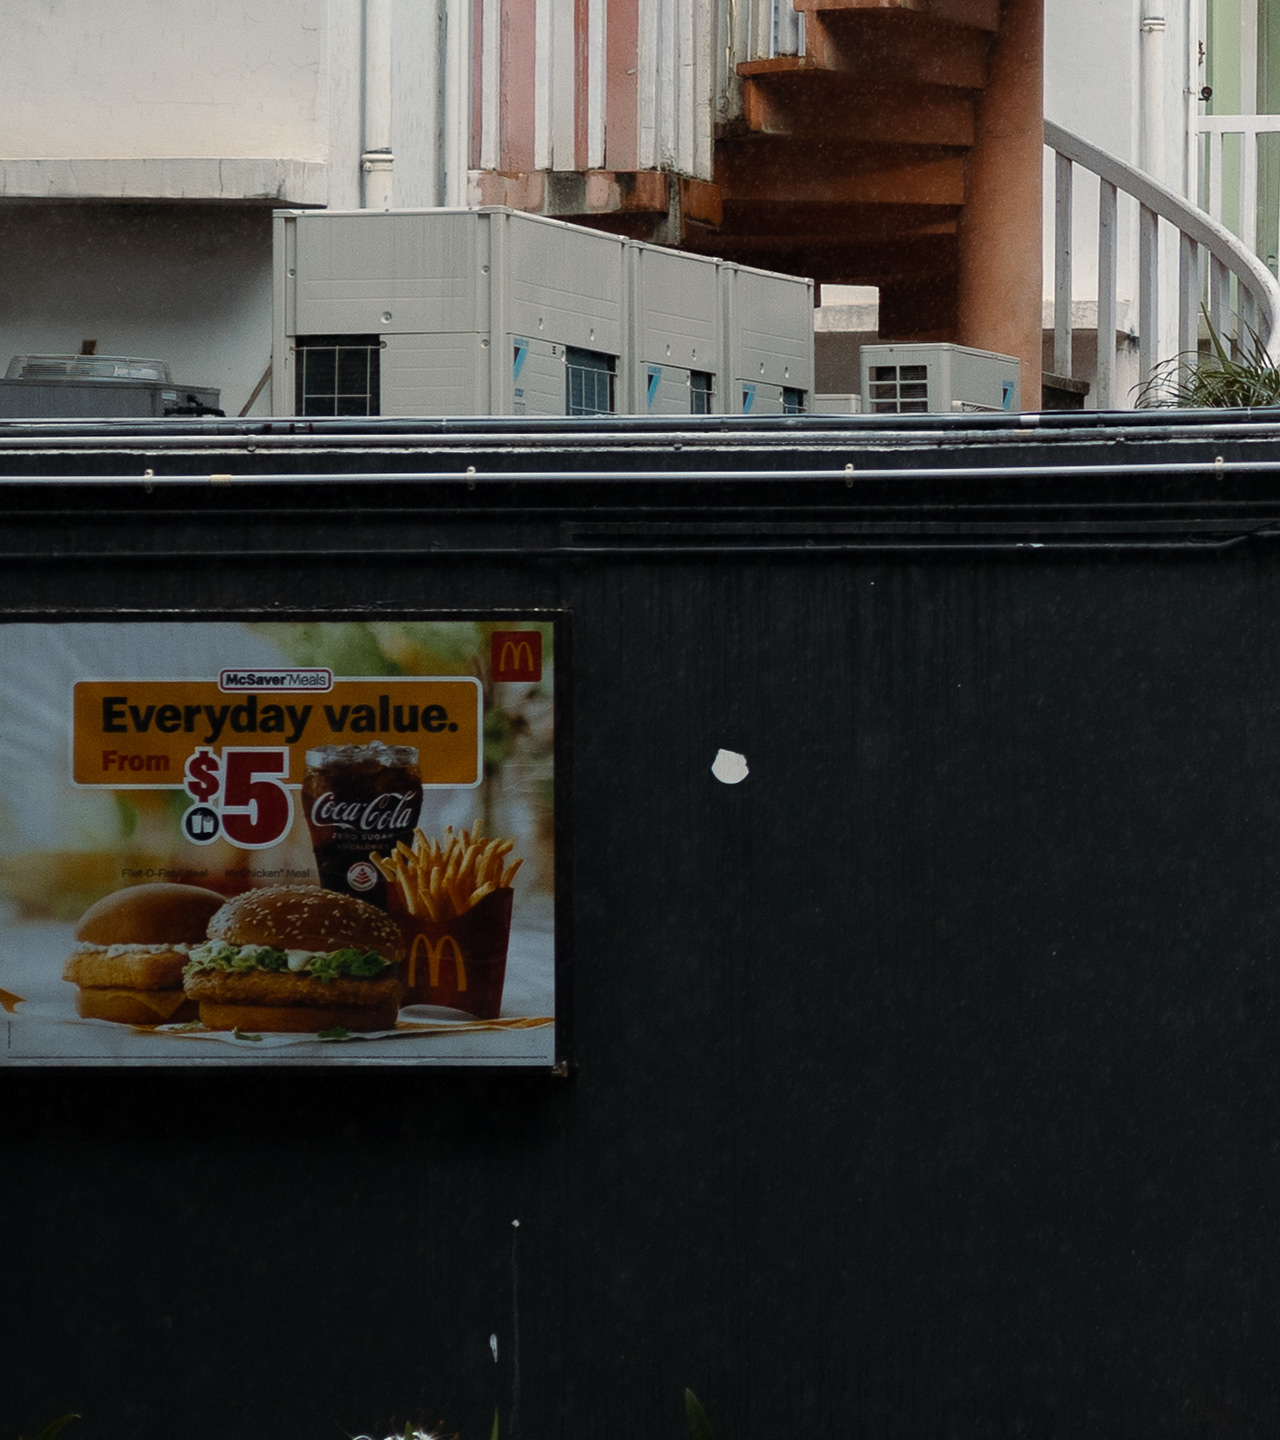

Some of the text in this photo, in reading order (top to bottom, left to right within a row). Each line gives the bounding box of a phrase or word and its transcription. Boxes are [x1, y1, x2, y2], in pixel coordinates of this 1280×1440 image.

[102, 695, 459, 744] Everyday value.
[102, 750, 170, 772] From
[186, 748, 292, 847] $5
